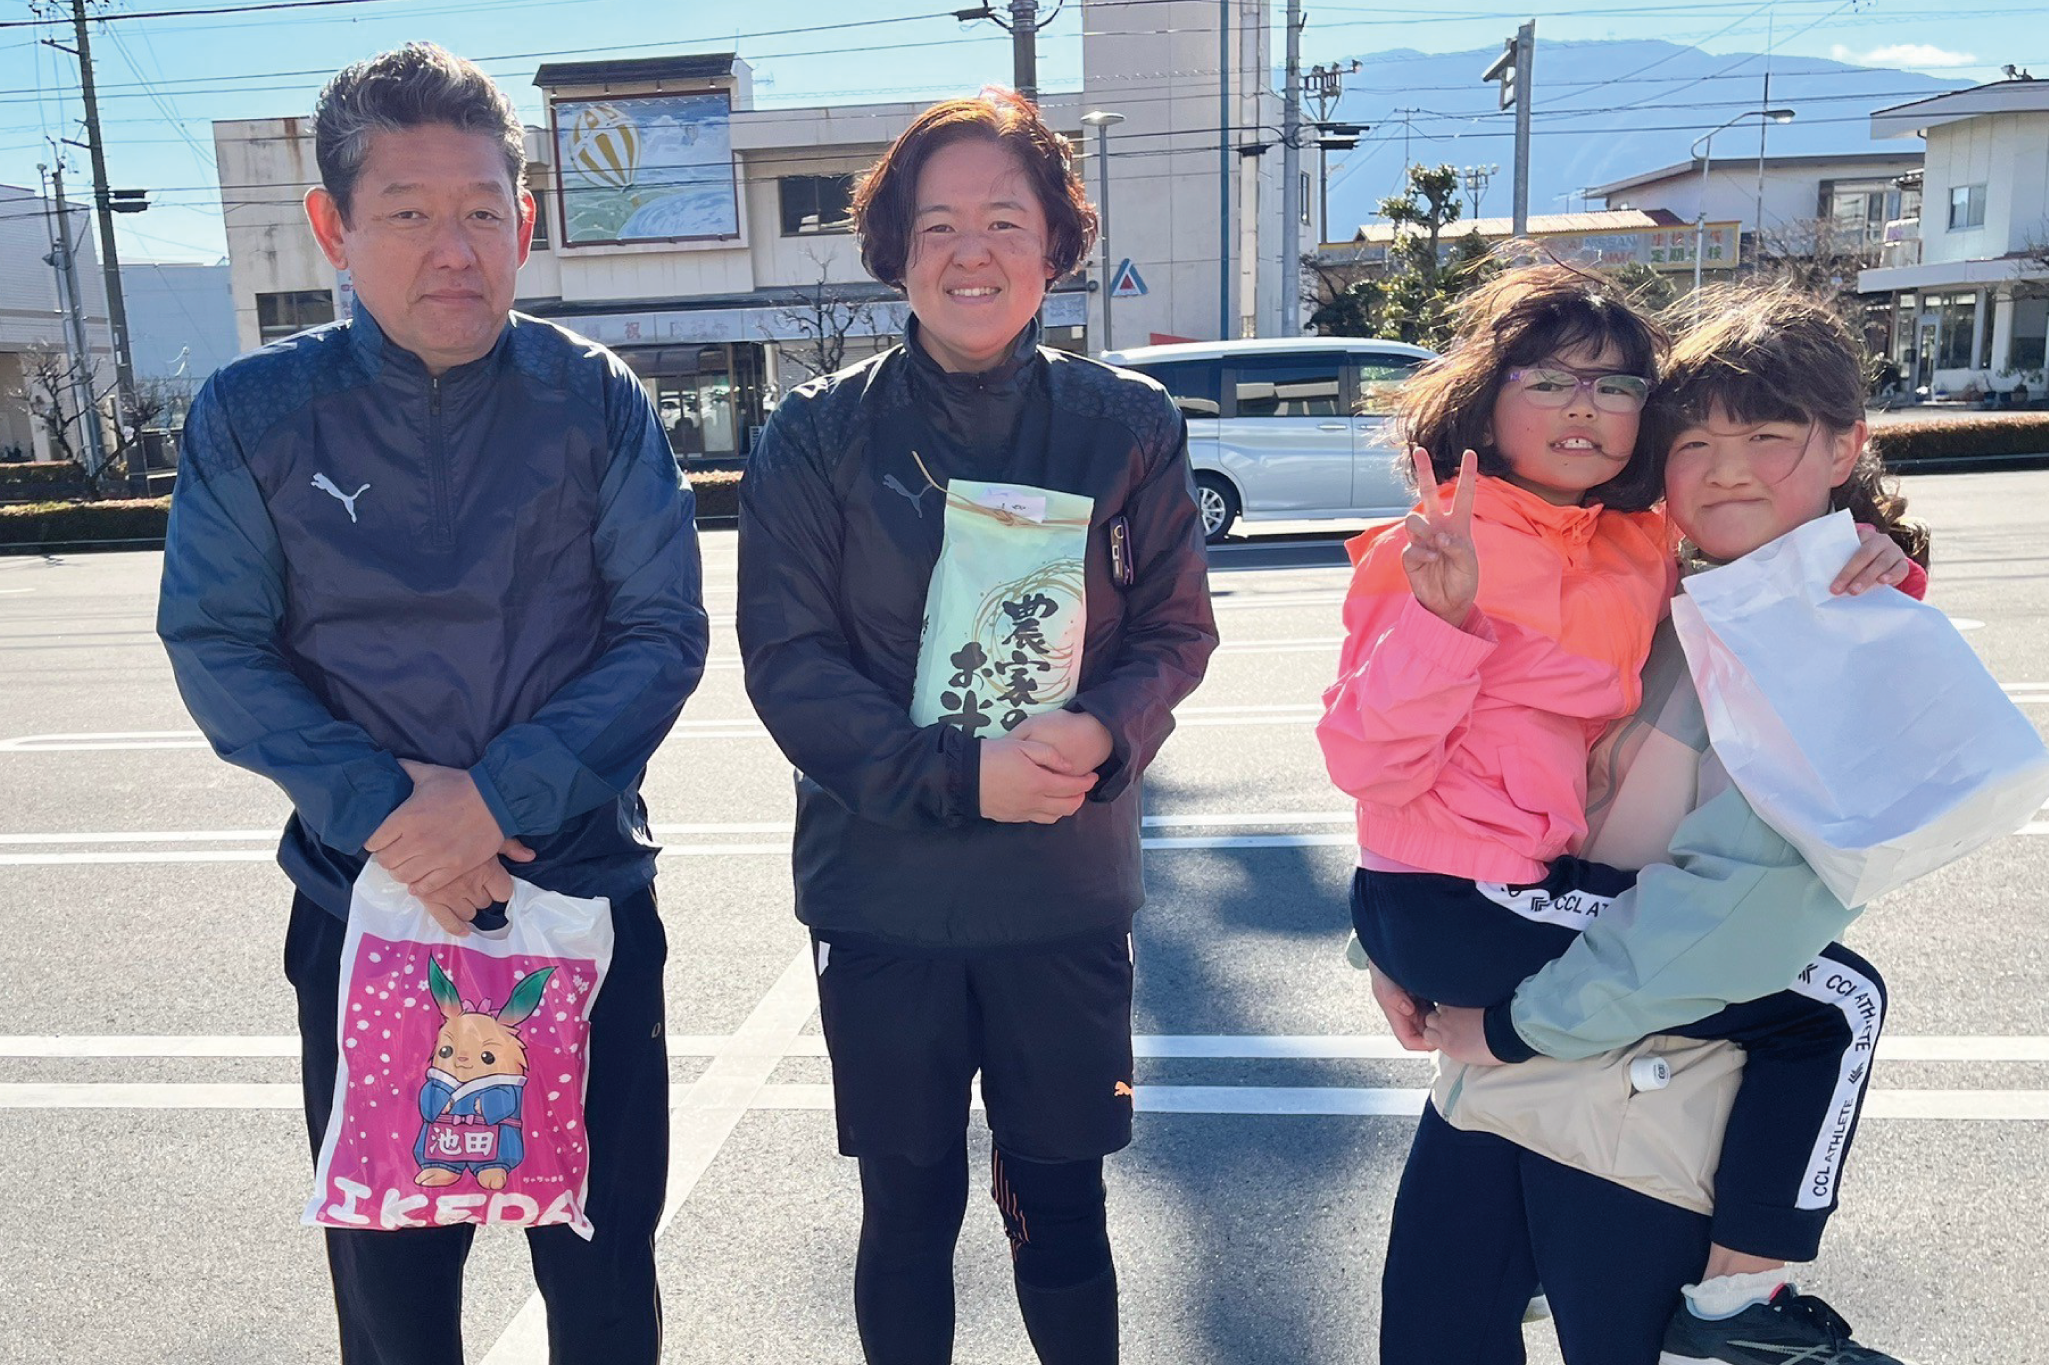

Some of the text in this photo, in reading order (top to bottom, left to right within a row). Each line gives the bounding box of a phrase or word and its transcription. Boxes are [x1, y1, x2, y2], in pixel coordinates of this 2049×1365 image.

[1554, 895, 1581, 913] CCL
[430, 1127, 495, 1155] 池田
[1812, 1098, 1853, 1197] CCL ATHLETE
[326, 1176, 587, 1228] IKEDA
